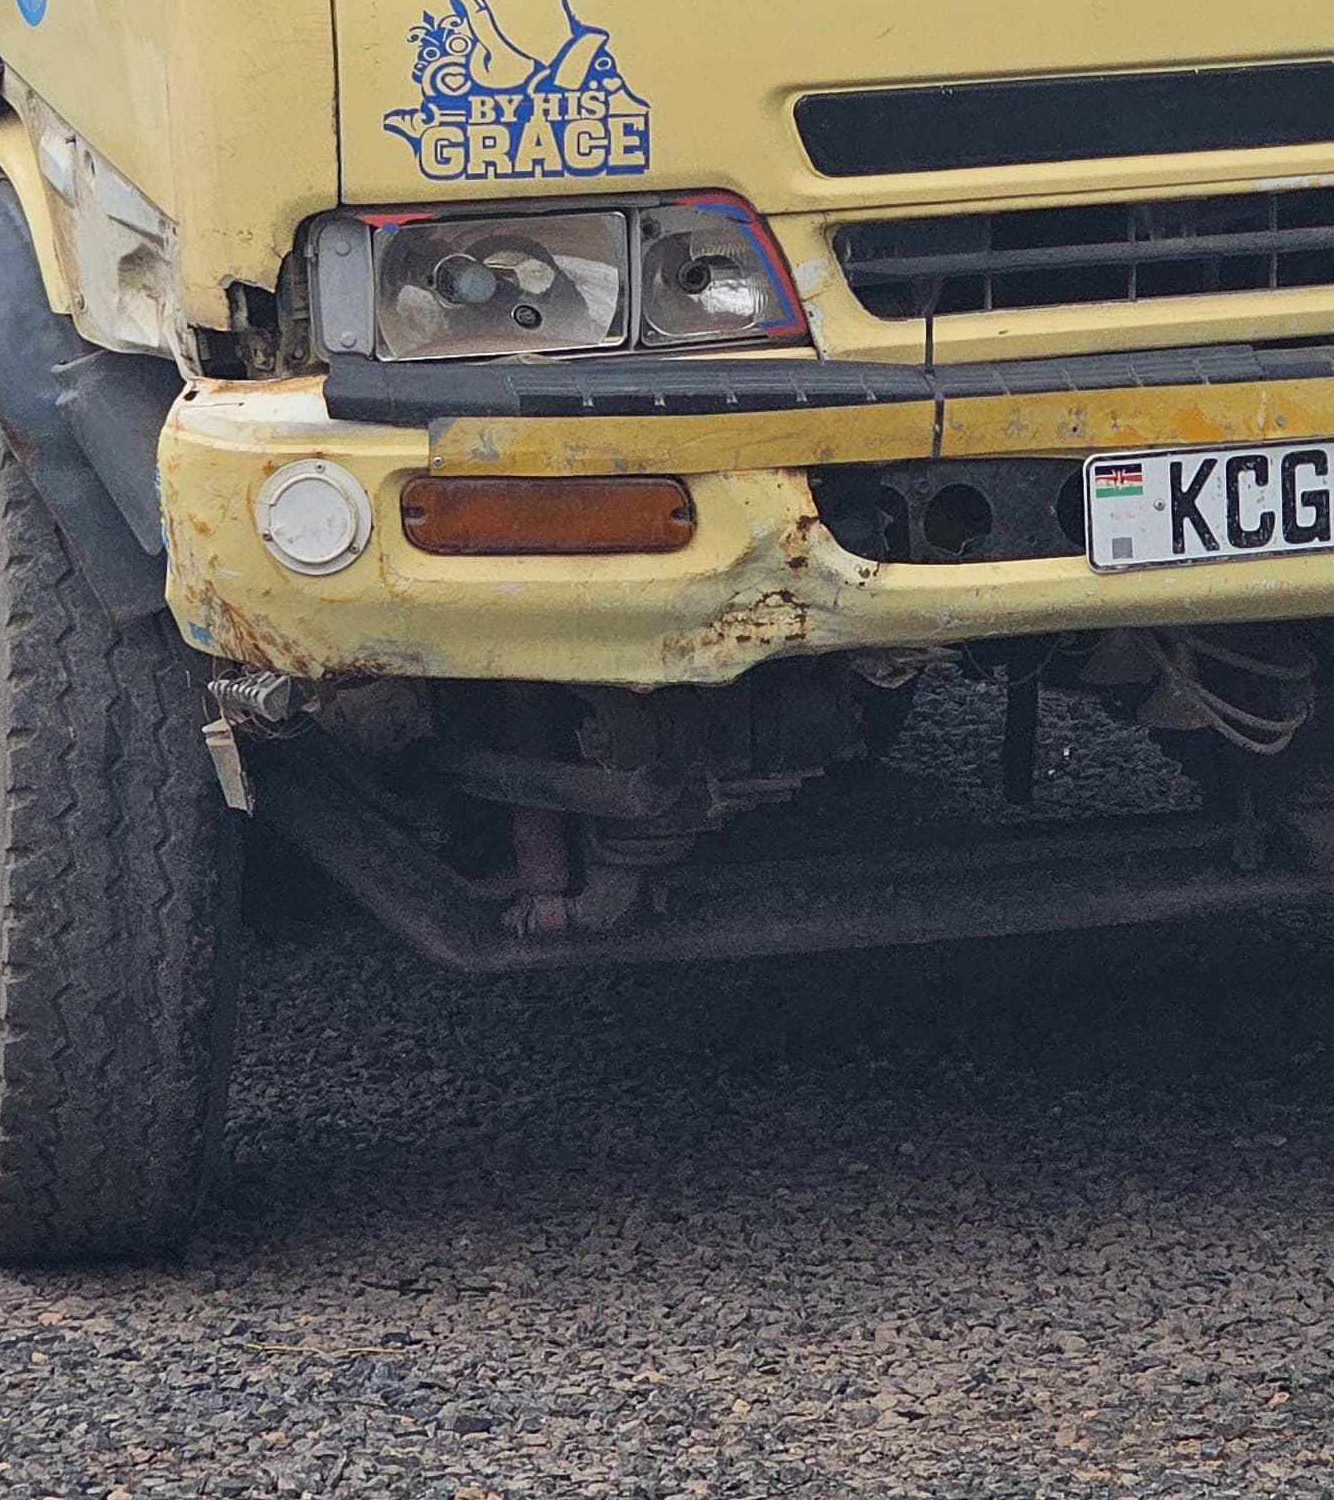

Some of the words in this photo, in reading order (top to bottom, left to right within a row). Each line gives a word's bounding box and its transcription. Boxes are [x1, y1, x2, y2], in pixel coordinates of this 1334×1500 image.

[468, 94, 524, 124] BY
[533, 90, 606, 122] HIS
[419, 117, 649, 179] GRACE
[1169, 449, 1331, 555] KCG
